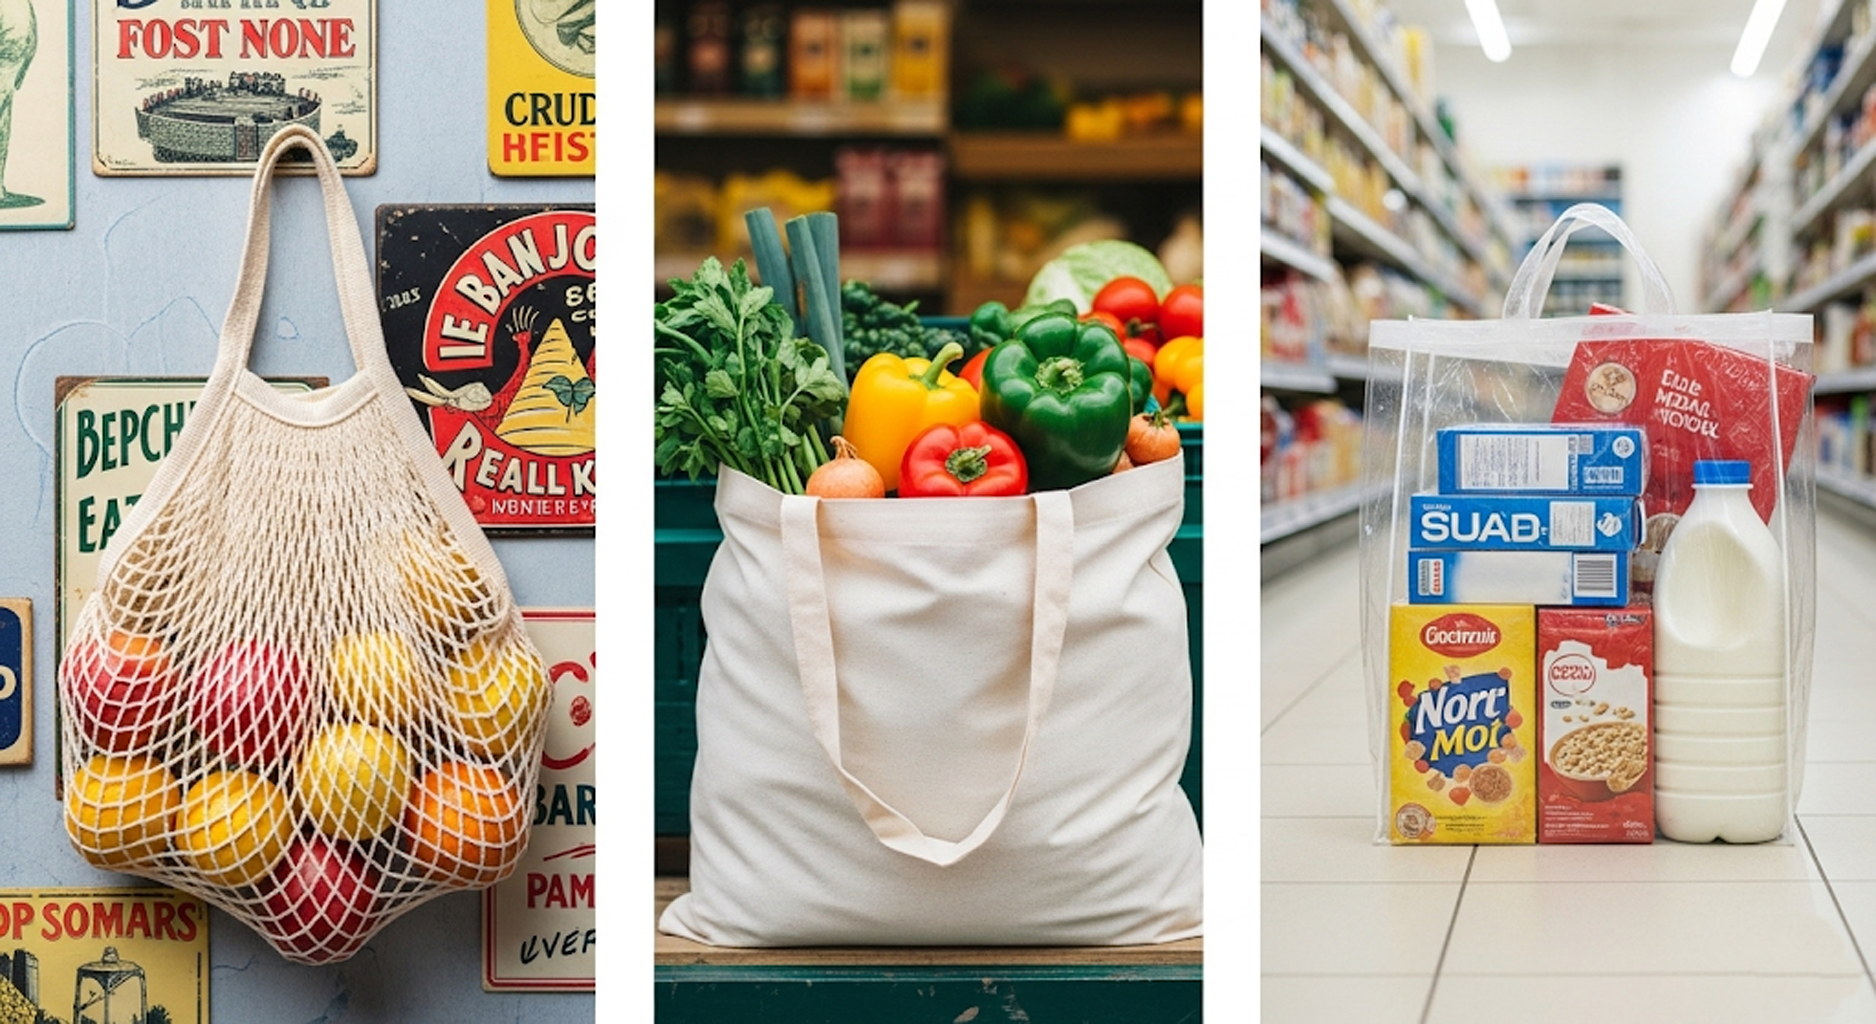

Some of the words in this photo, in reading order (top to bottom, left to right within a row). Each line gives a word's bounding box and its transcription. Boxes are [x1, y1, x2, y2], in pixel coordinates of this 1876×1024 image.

[117, 18, 229, 59] FOST
[239, 18, 356, 59] NONE
[76, 400, 197, 480] BEPCH
[527, 873, 595, 909] PAM
[41, 901, 197, 942] SOMARS
